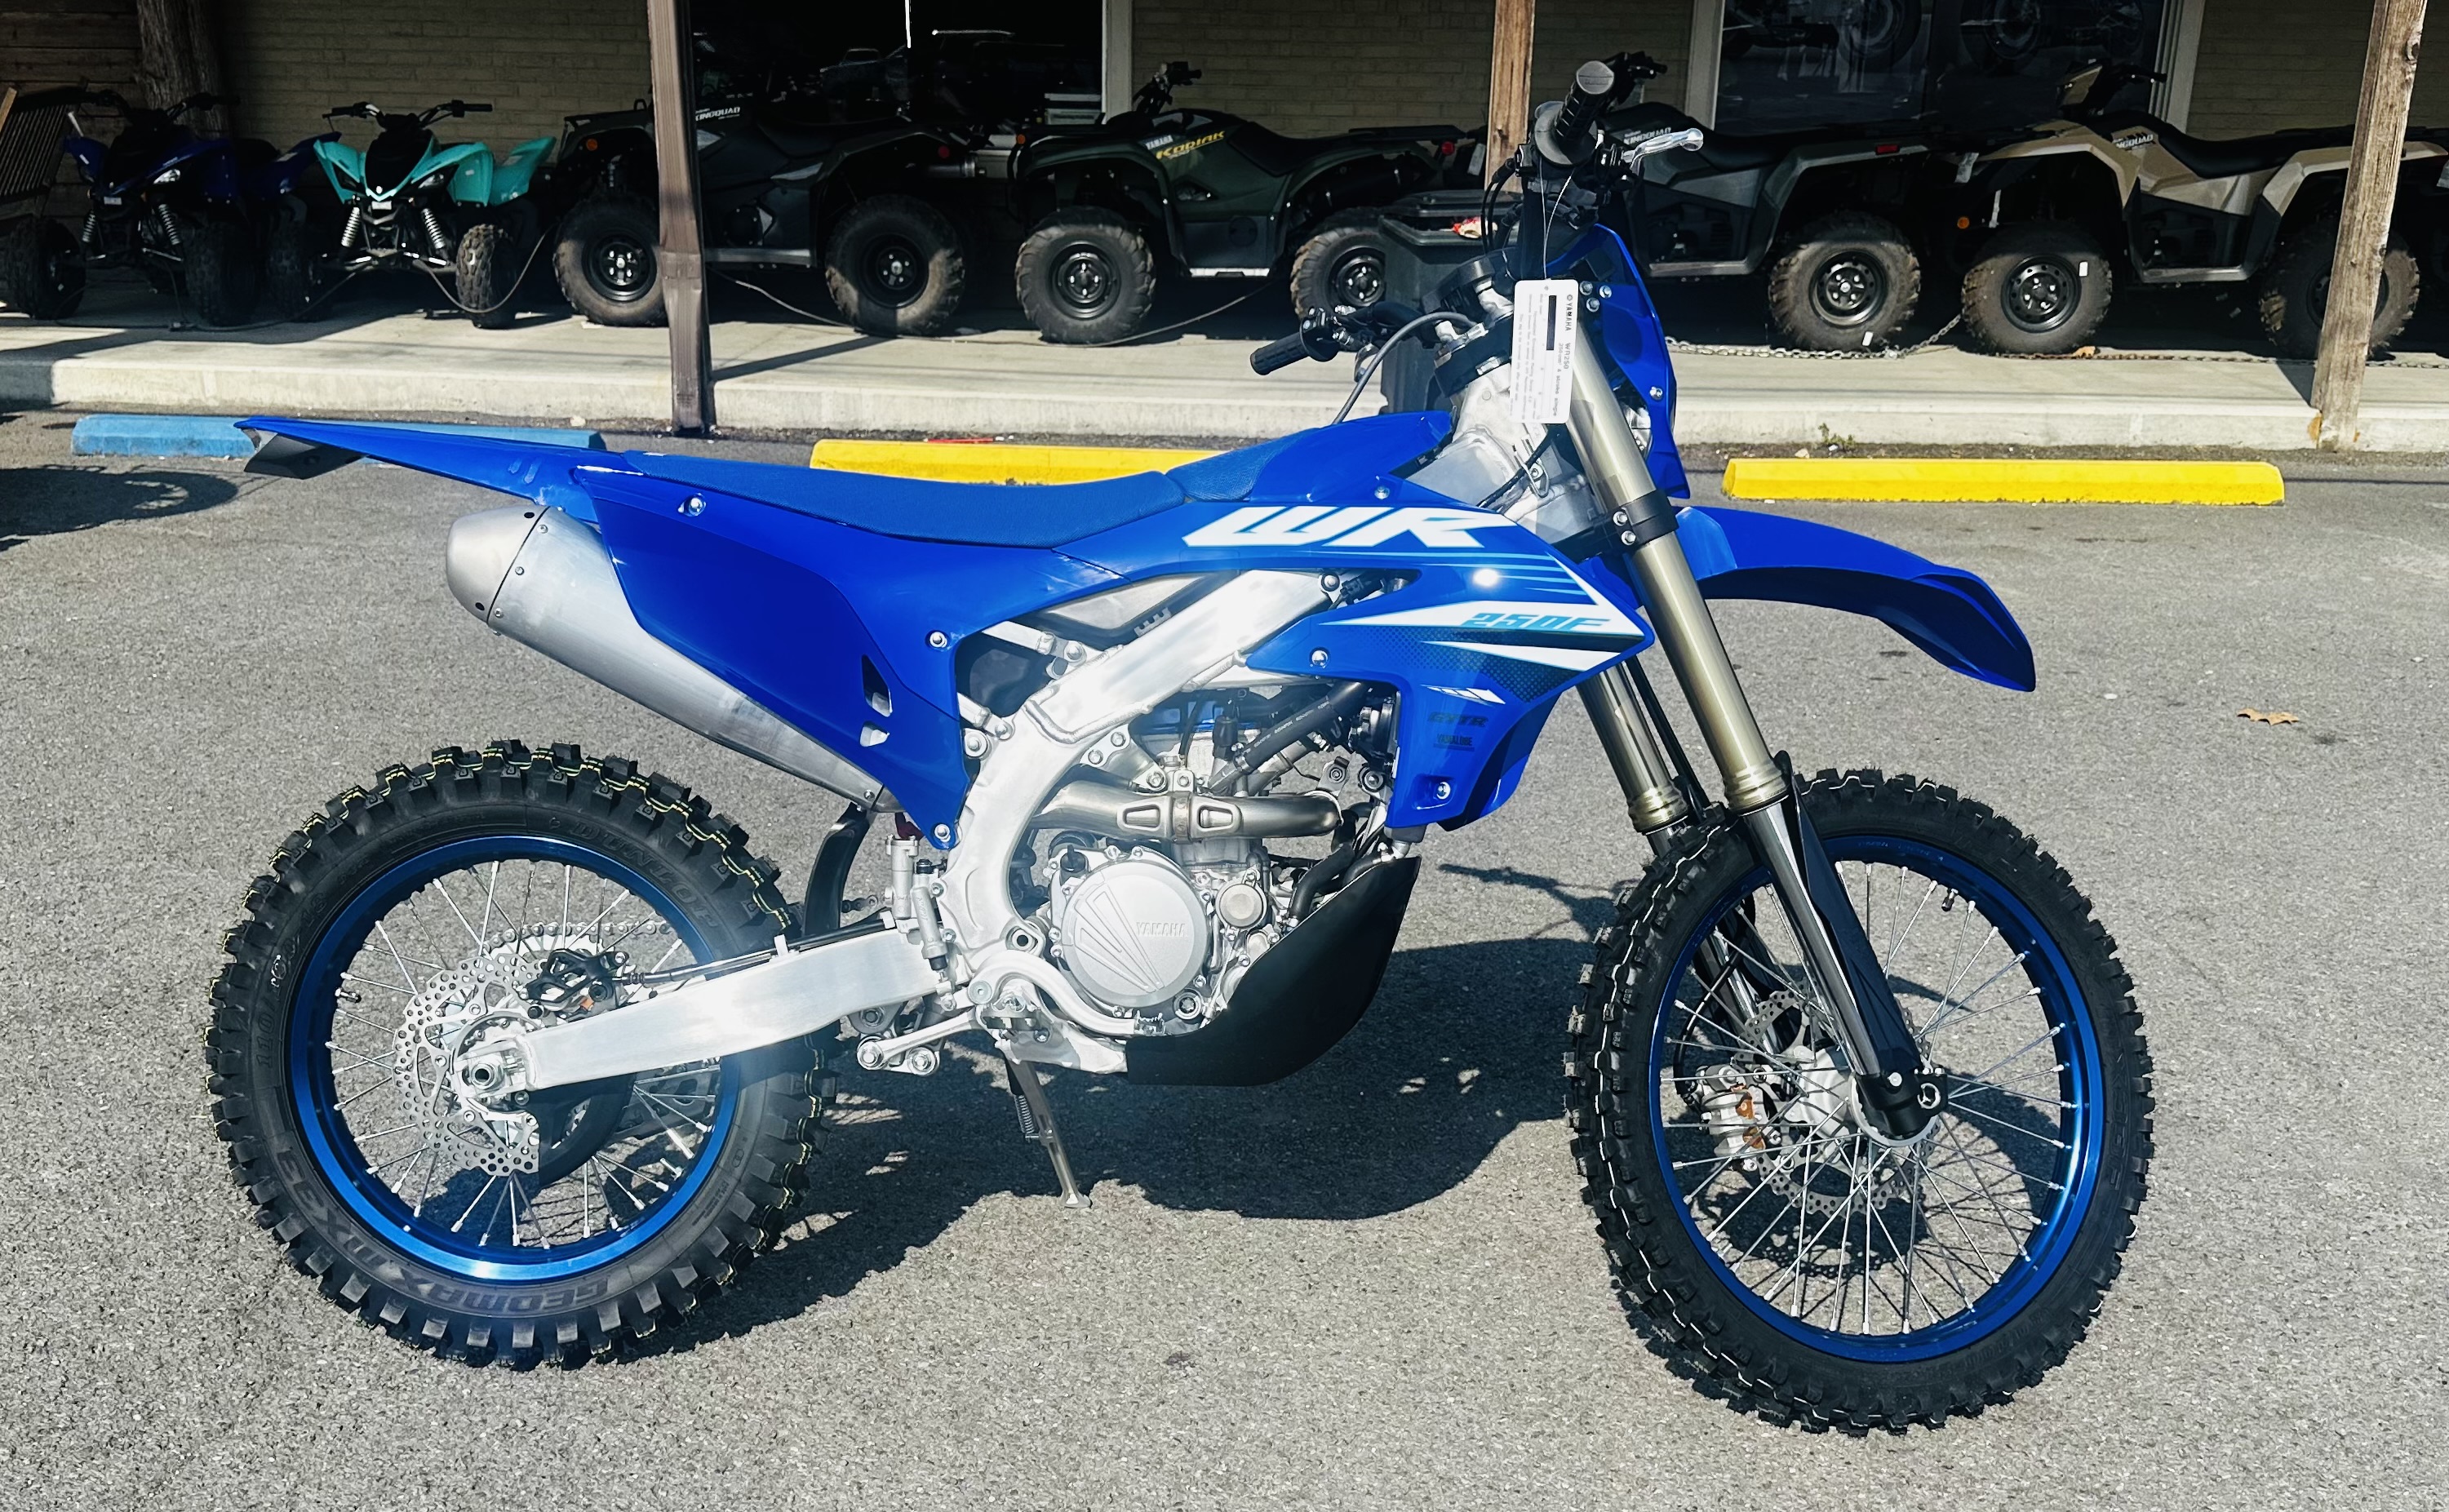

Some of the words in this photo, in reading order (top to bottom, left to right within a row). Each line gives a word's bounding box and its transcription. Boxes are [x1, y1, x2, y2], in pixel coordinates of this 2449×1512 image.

[1156, 131, 1225, 160] KODIAK
[1564, 303, 1573, 331] YAMAHA
[1182, 507, 1518, 548] WR
[1460, 613, 1611, 631] 250F
[570, 821, 719, 929] DUNLOP
[1136, 920, 1189, 938] YAMAHA
[398, 1266, 610, 1313] GEOMAX
